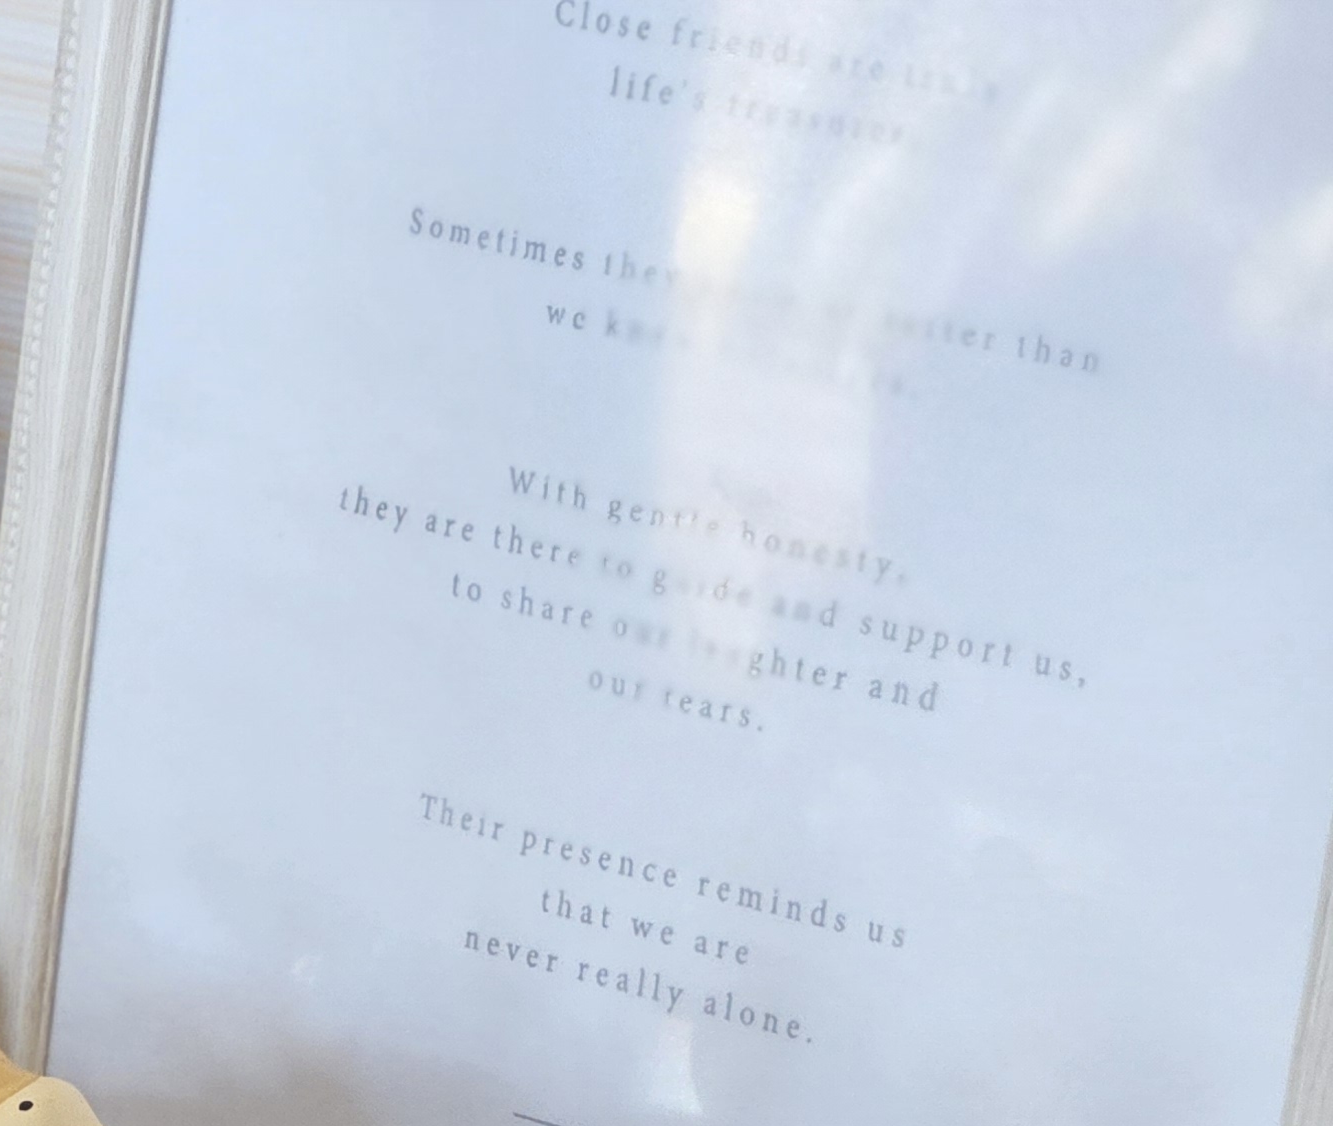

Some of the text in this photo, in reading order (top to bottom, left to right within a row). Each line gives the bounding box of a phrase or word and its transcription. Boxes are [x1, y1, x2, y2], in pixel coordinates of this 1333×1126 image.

[555, 0, 652, 42] Close
[671, 17, 806, 67] friends
[829, 55, 885, 82] are
[609, 65, 705, 112] life's
[408, 205, 585, 271] Sometimes
[603, 250, 677, 288] they
[1017, 333, 1101, 375] than
[546, 304, 587, 331] we
[509, 465, 587, 511] With
[339, 484, 1087, 689] they are there to gde and support us,
[452, 573, 939, 712] to share our lghter and
[587, 670, 763, 732] our tears.
[420, 791, 906, 948] Their presence reminds us
[541, 889, 750, 966] that we are
[464, 930, 813, 1044] never really alone.
